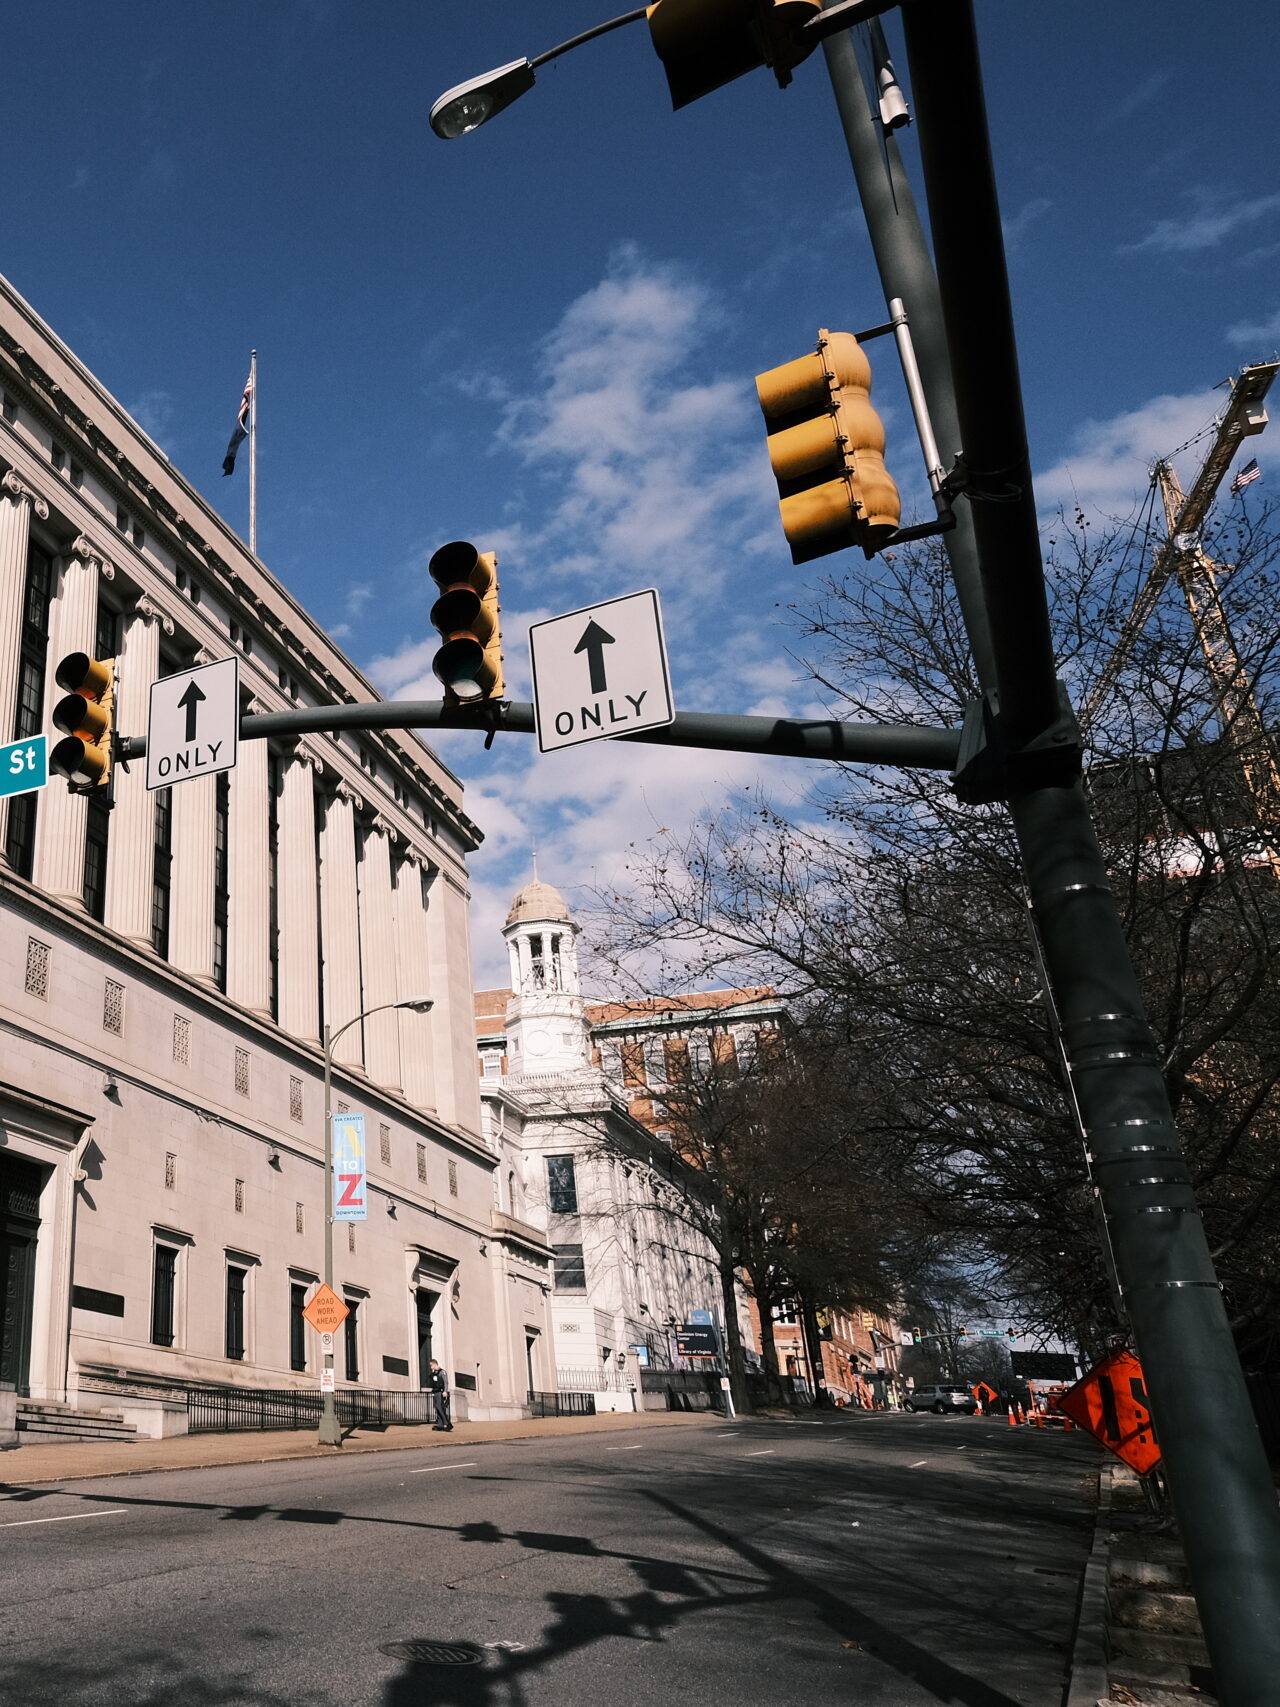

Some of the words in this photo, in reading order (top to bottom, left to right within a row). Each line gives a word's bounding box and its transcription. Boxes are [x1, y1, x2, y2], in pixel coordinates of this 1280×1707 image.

[555, 690, 648, 736] ONLY
[9, 746, 36, 775] St
[158, 740, 223, 777] ONLY
[342, 1160, 358, 1171] TO
[336, 1174, 364, 1206] Z
[316, 1298, 334, 1306] ROAD
[317, 1307, 335, 1315] WORK
[316, 1317, 338, 1325] AHEAD
